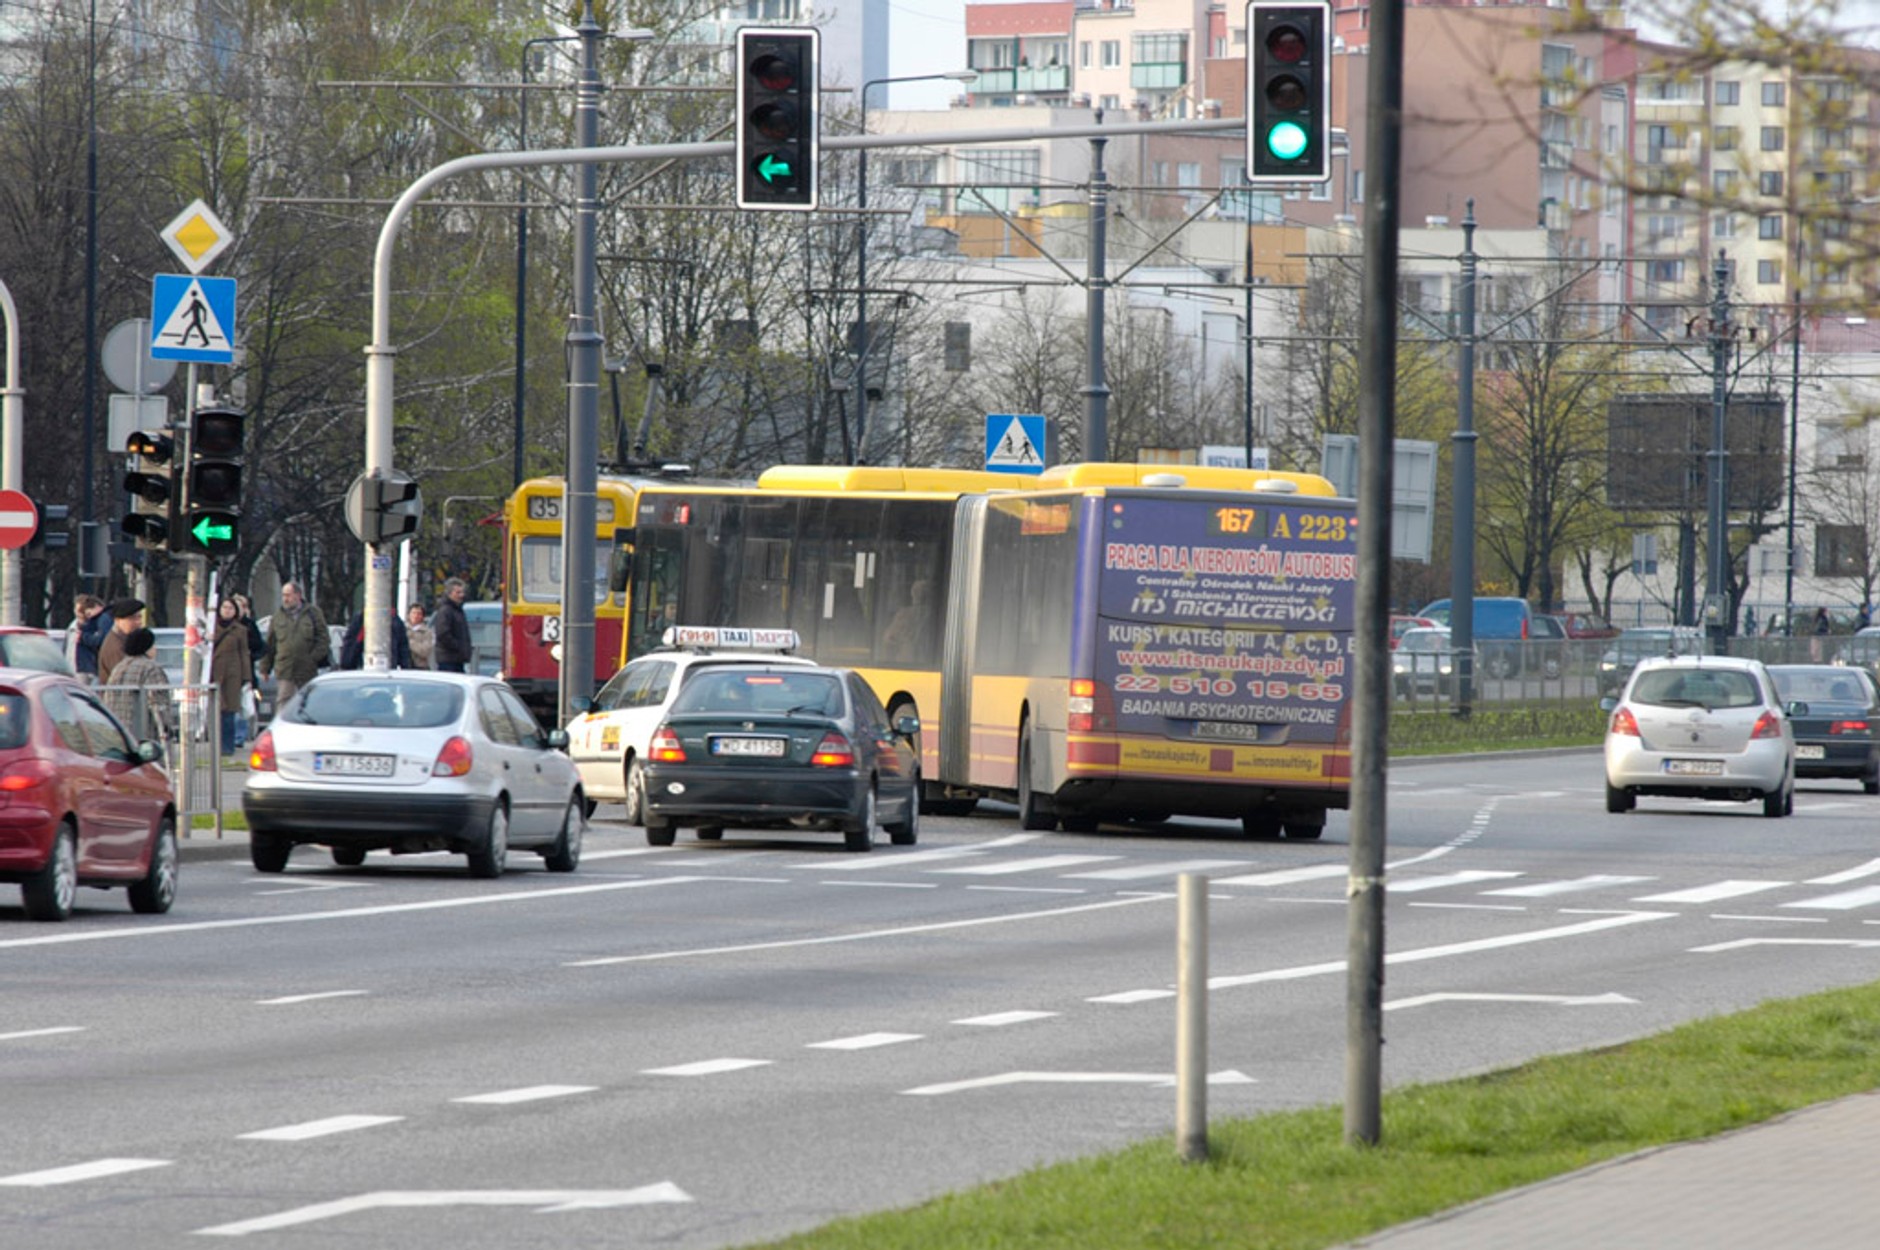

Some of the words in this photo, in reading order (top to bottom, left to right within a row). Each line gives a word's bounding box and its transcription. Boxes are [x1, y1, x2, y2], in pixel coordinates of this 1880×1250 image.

[534, 496, 559, 518] 35
[1216, 508, 1255, 532] 167
[1272, 513, 1292, 538] A
[1299, 514, 1347, 541] 223
[1106, 543, 1157, 571] PRACA
[1160, 545, 1189, 572] DLA
[1192, 544, 1282, 577] KIEROWCÓW
[1137, 575, 1198, 588] Centralny
[1201, 578, 1253, 589] Ośrodek
[1256, 581, 1294, 591] Nauki
[1297, 583, 1334, 595] Jazdy
[1171, 589, 1231, 600] Szkolenia
[1235, 592, 1306, 604] Kierowców
[1131, 598, 1166, 614] ITS
[723, 630, 748, 642] TAXI
[1109, 625, 1162, 644] KURSY
[1168, 629, 1254, 648] KATEGORII
[1264, 632, 1281, 652] A,
[1285, 633, 1301, 653] B,
[1305, 634, 1321, 654] C,
[1326, 636, 1342, 654] D,
[1117, 650, 1344, 679] www.itsnaukajazdy.pl
[1115, 674, 1160, 692] 22
[1170, 677, 1236, 696] 510
[1247, 680, 1288, 699] 15
[1298, 683, 1343, 701] 55
[1122, 699, 1185, 717] BADANIA
[1188, 702, 1337, 724] PSYCHOTECHNICZNE
